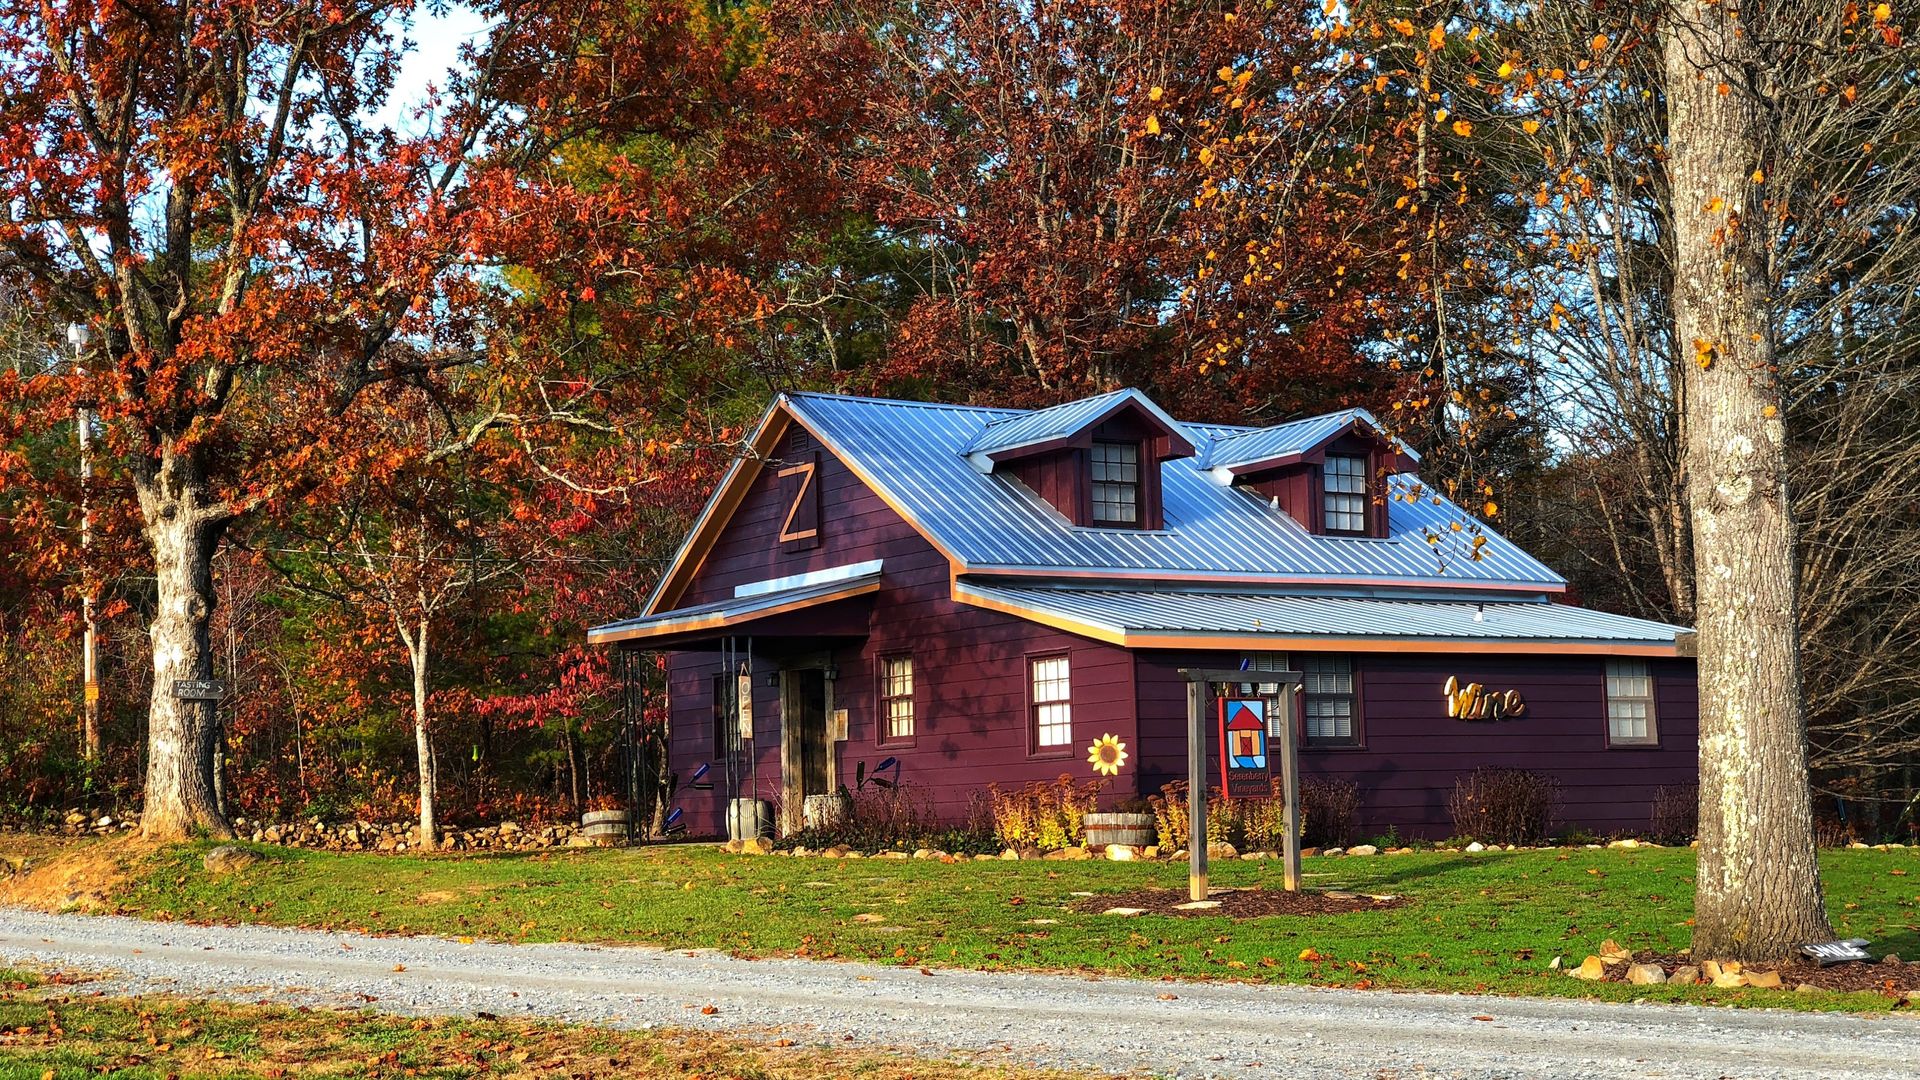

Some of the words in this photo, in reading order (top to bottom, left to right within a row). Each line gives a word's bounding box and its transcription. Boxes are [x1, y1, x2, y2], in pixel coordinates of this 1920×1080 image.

[176, 681, 211, 689] TASTING
[178, 689, 206, 697] ROOM
[1444, 675, 1525, 720] Wine
[741, 681, 752, 733] OPEN
[1232, 783, 1268, 794] Vineyards
[1804, 942, 1865, 957] SMILE
